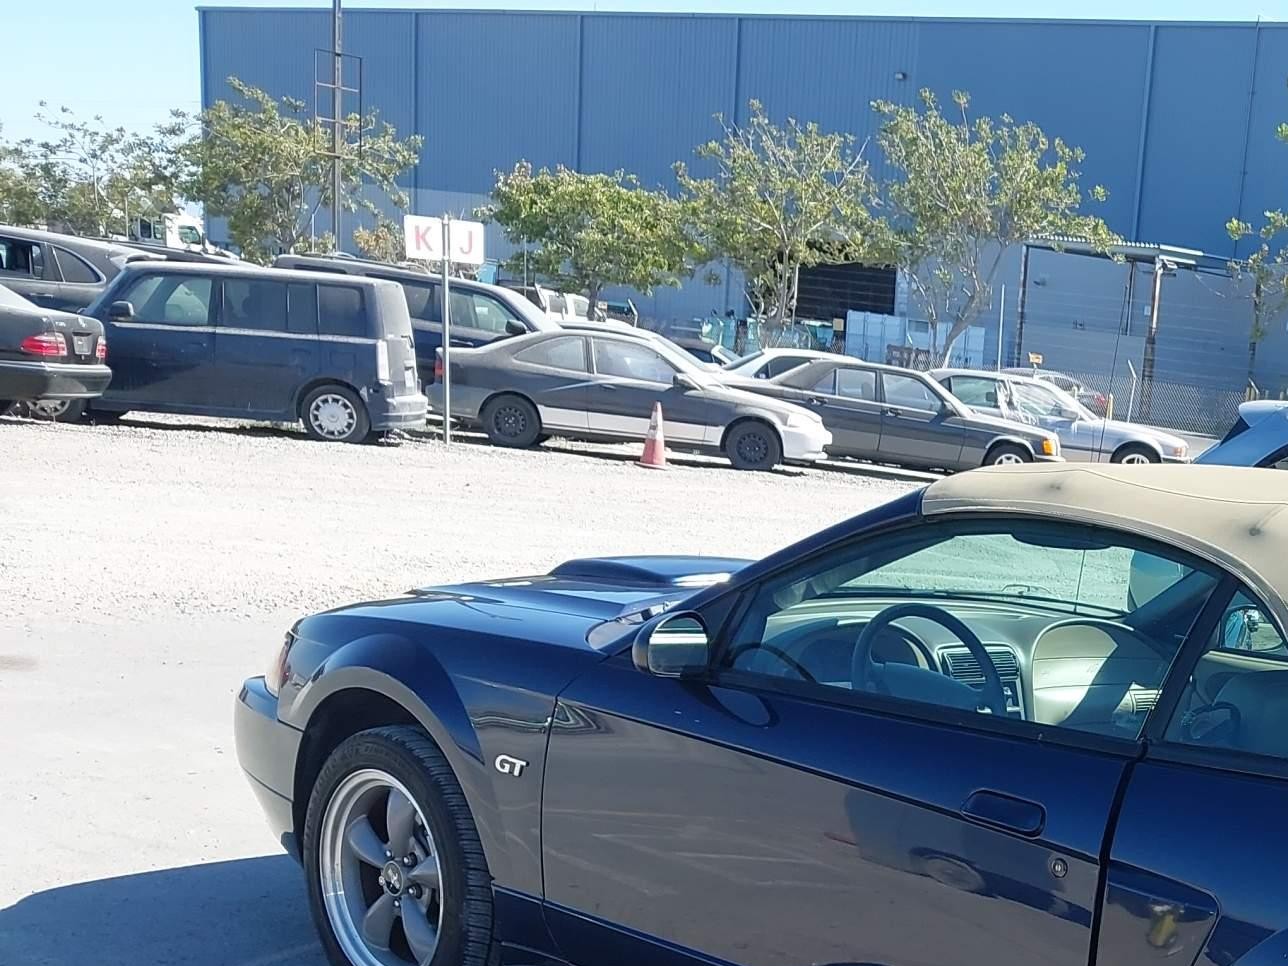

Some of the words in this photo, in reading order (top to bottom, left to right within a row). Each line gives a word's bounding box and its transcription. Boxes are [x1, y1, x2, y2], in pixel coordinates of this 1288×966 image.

[415, 225, 433, 251] K
[459, 230, 473, 255] J
[494, 754, 527, 777] GT
